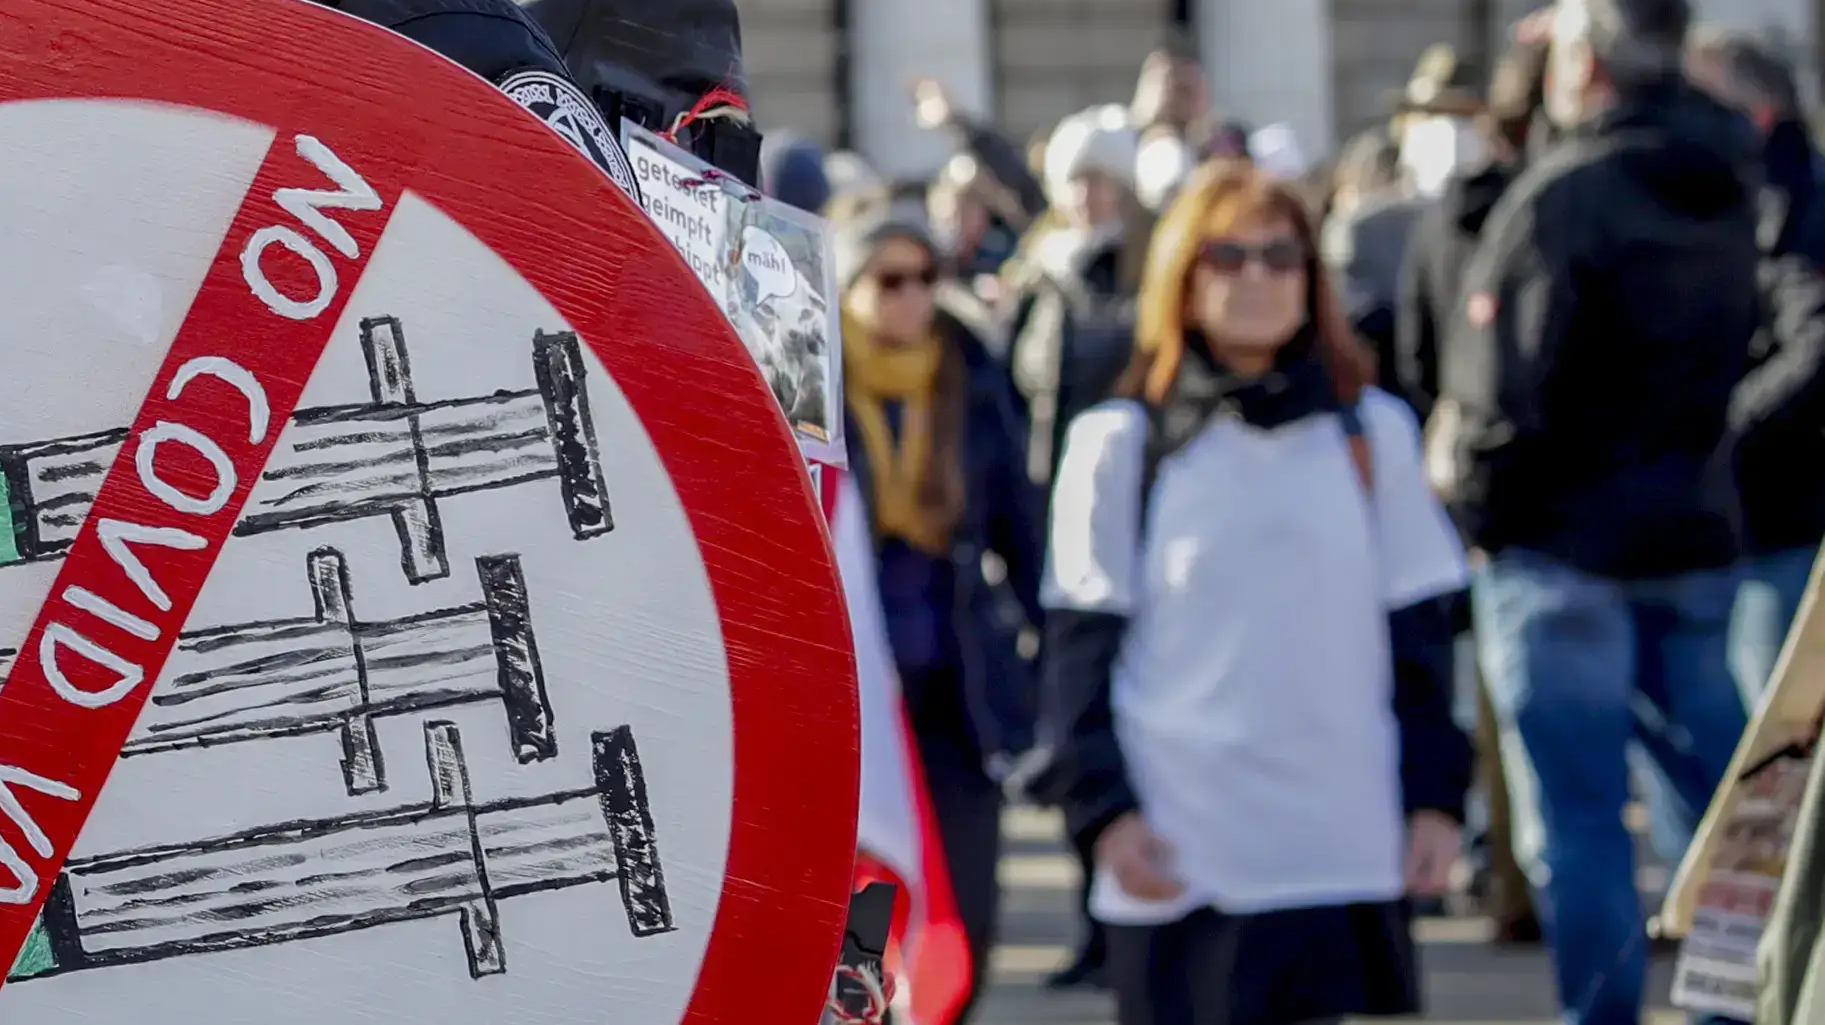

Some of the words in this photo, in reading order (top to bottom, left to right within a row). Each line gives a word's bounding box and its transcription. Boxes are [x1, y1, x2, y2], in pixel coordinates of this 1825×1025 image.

[239, 134, 384, 321] NO
[641, 192, 713, 247] geimpft
[37, 355, 271, 709] COVID
